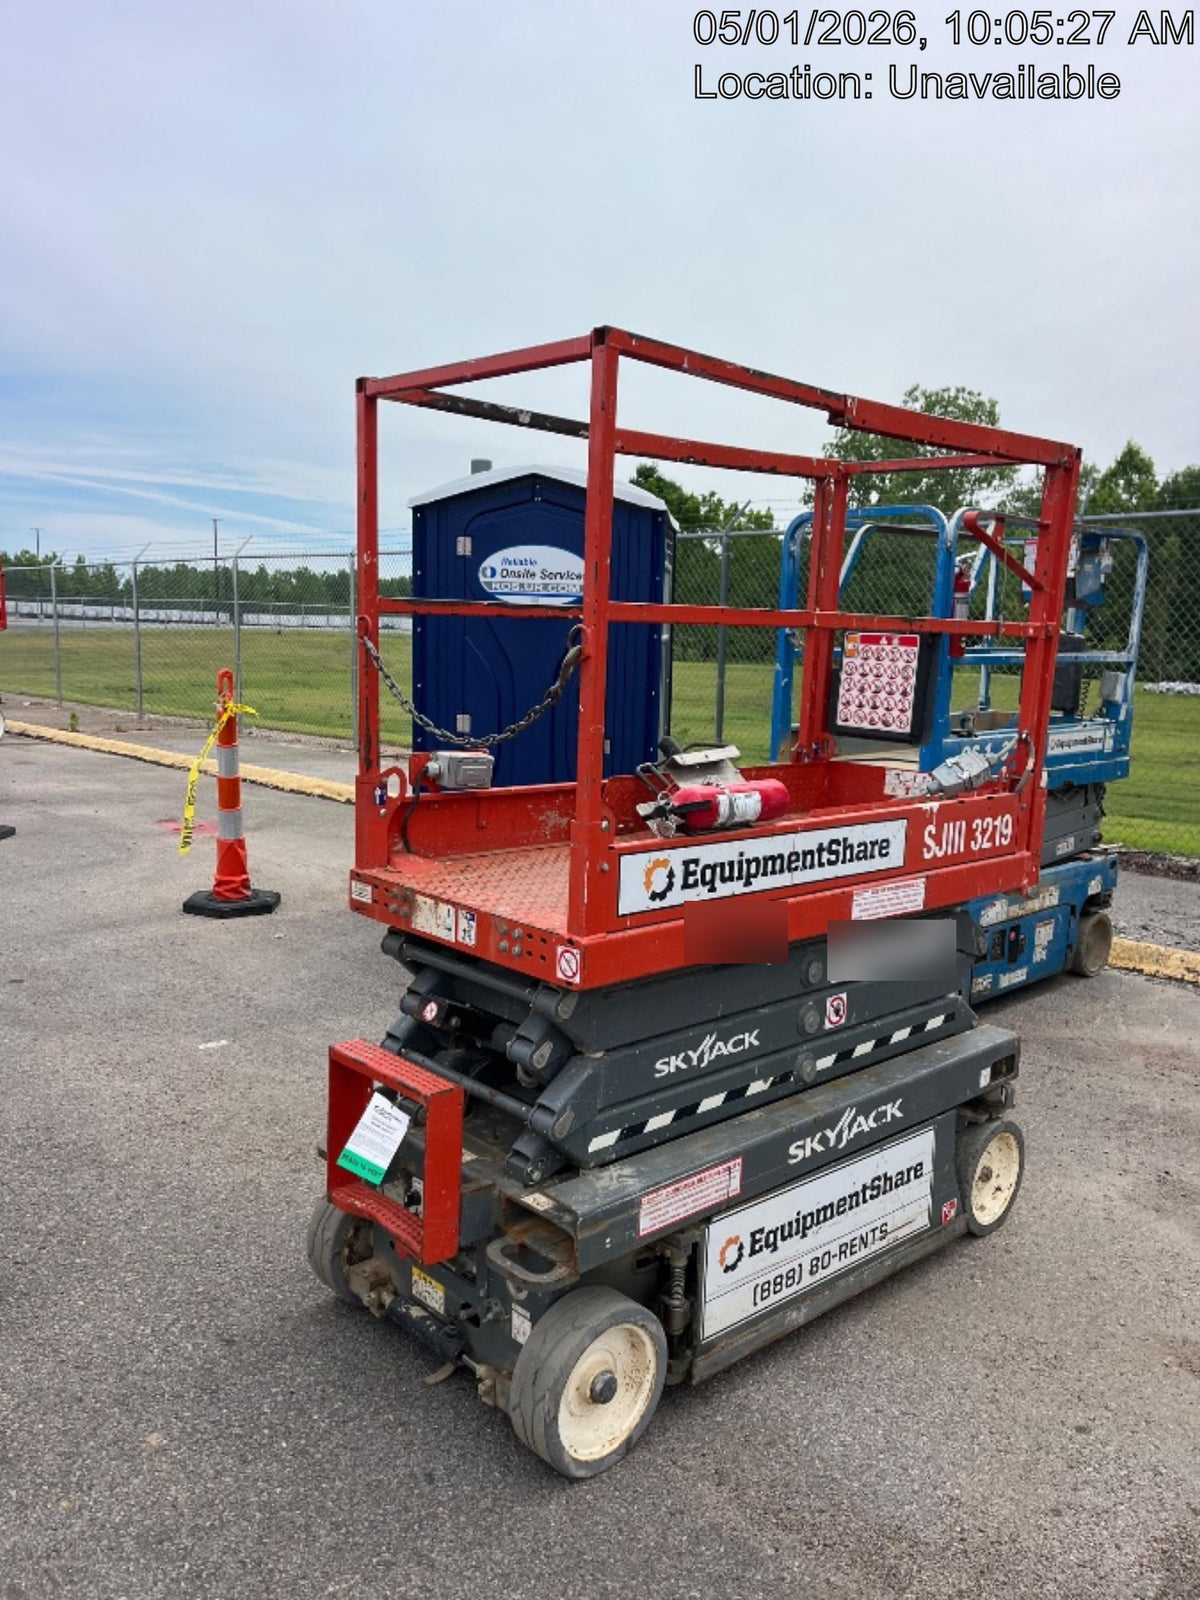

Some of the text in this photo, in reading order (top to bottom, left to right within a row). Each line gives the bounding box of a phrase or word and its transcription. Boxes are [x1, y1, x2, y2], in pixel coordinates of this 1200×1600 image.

[501, 568, 583, 580] Onsite Service
[922, 820, 966, 860] SJIII
[970, 813, 1013, 851] 3219
[680, 837, 891, 893] EquipmentShare
[653, 1028, 760, 1078] SKYJACK
[787, 1098, 904, 1165] SKYJACK
[748, 1161, 924, 1258] EquipmentShare
[752, 1263, 803, 1307] (888)
